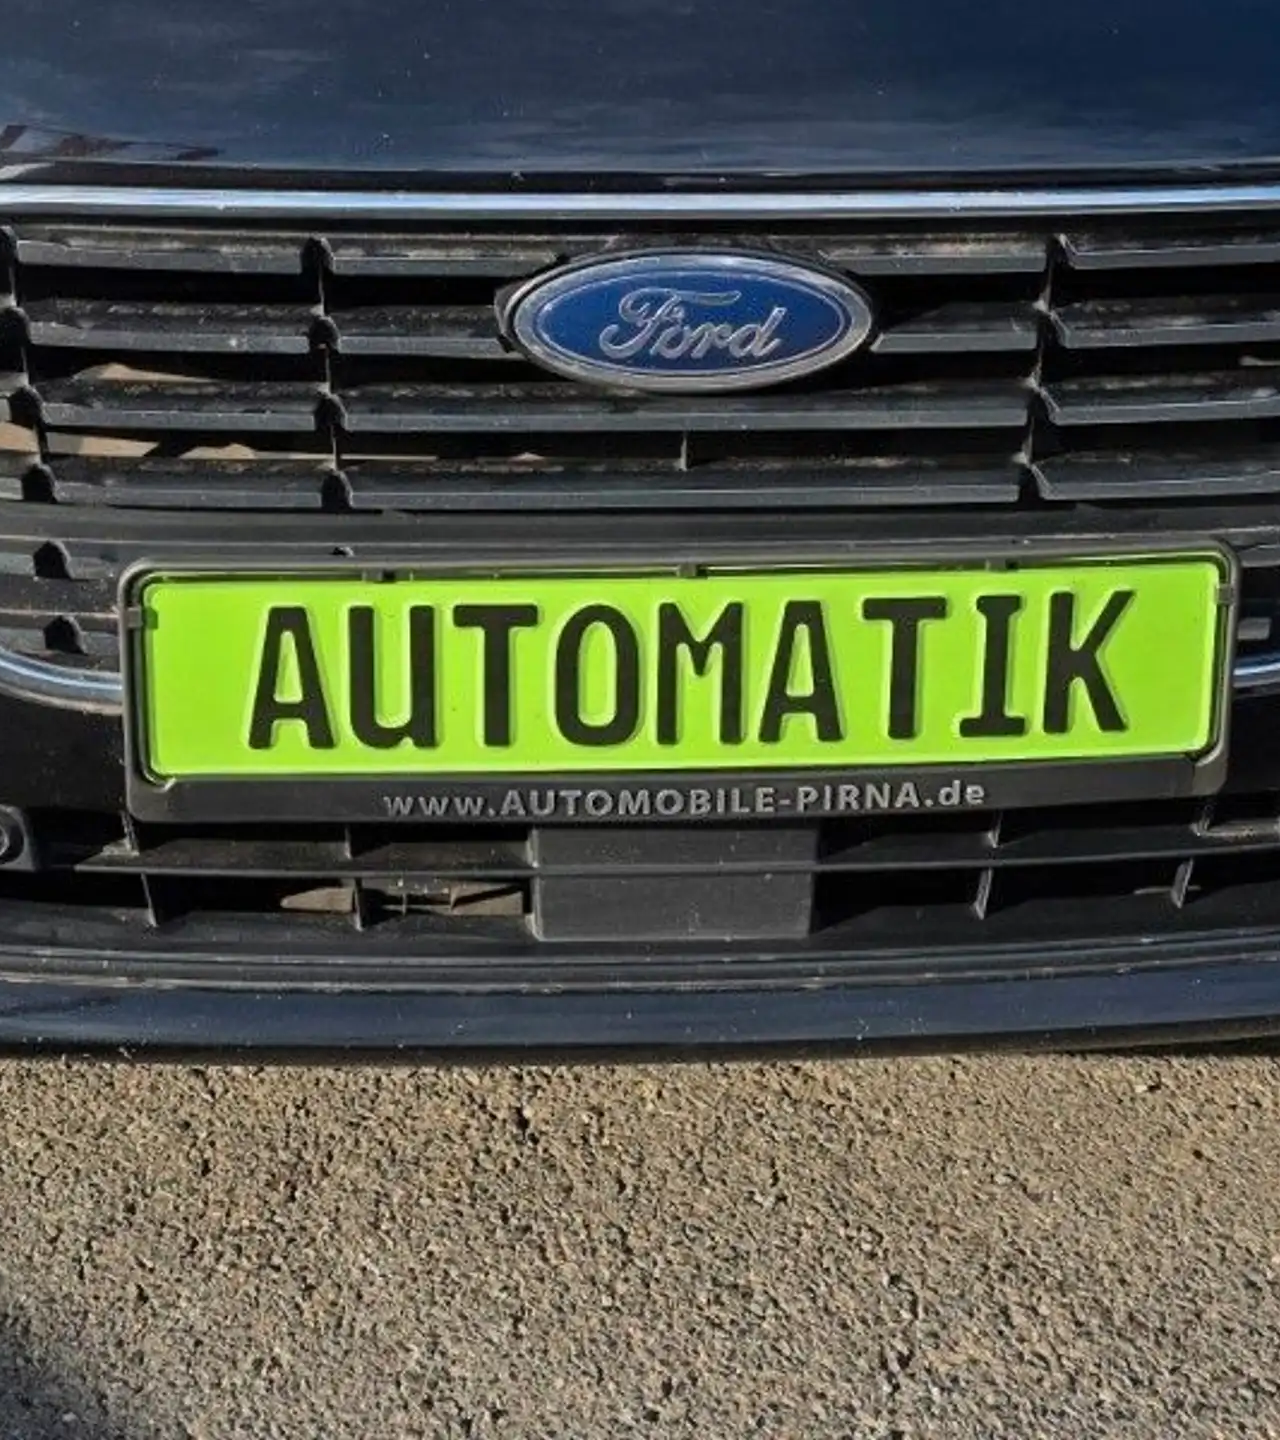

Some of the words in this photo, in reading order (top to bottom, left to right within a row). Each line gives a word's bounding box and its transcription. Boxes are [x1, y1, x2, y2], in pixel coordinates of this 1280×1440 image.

[598, 286, 788, 359] Ford
[247, 588, 1138, 751] AUTOMATIK
[382, 778, 987, 818] www.AUTOMOBILE-PIRNA.de
